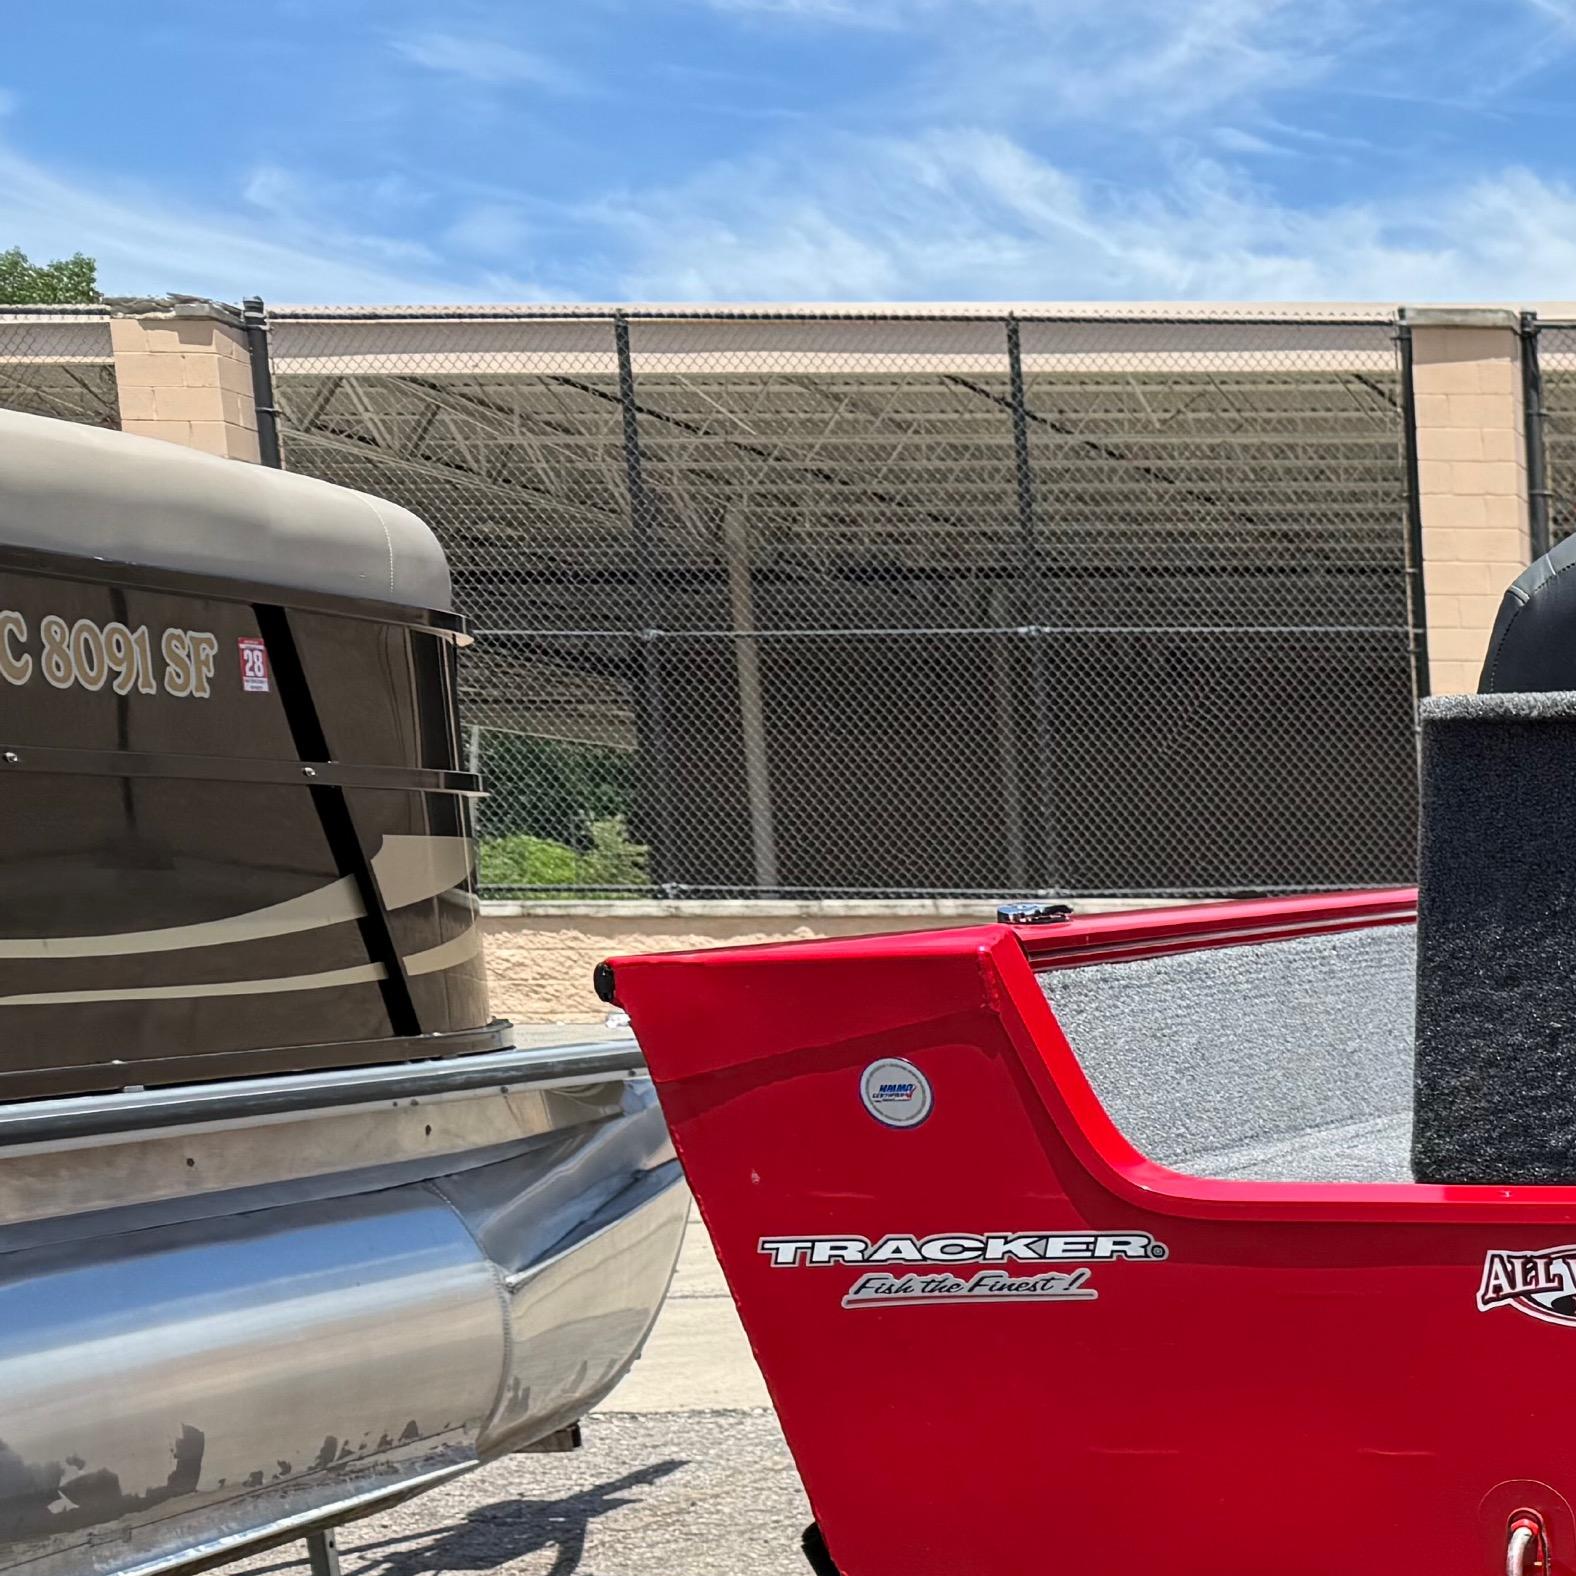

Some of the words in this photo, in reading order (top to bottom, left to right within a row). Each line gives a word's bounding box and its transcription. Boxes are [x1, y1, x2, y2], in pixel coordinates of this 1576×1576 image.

[41, 615, 157, 695] 8091
[162, 628, 218, 698] SF
[243, 649, 265, 677] 28
[762, 1235, 1150, 1265] TRACKER
[853, 1275, 914, 1296] Fish
[918, 1274, 964, 1295] the
[1483, 1256, 1562, 1299] ALL
